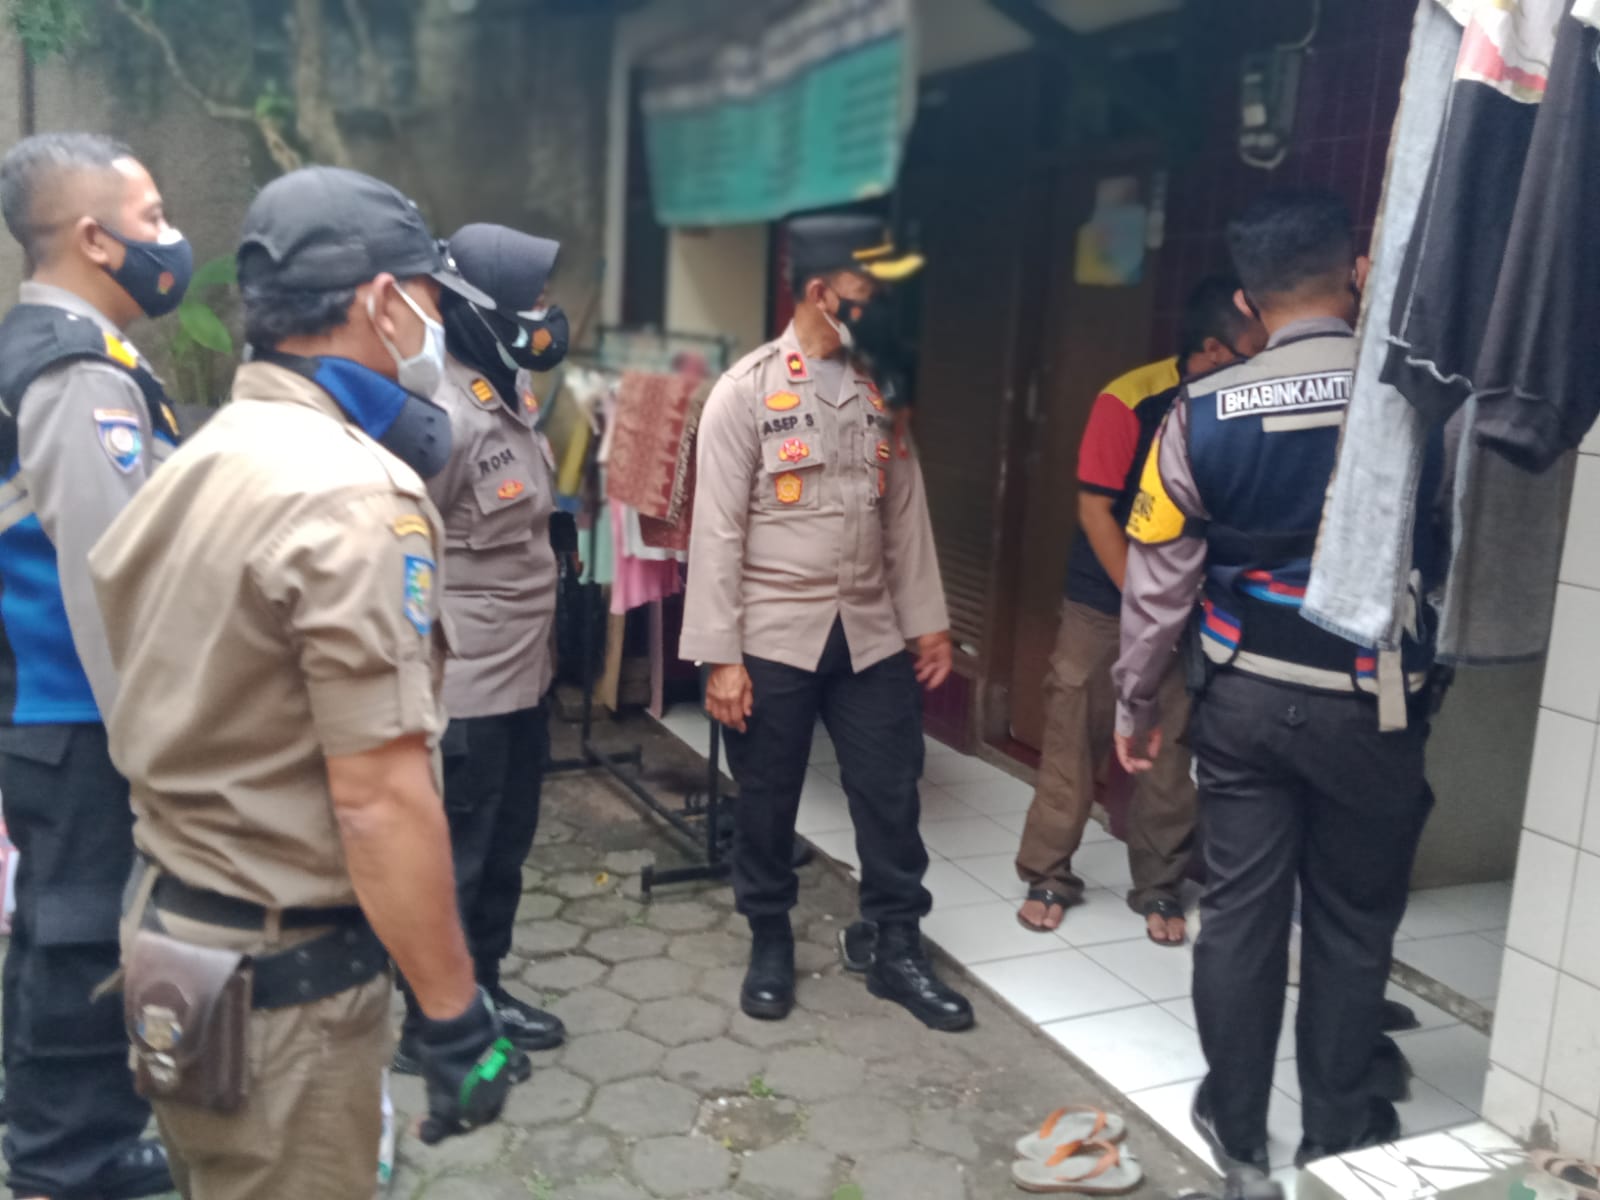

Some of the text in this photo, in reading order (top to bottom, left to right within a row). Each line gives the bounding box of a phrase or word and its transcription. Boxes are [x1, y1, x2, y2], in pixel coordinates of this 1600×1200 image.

[1225, 375, 1352, 412] BHABINKAMTI
[763, 413, 814, 436] ASEP S
